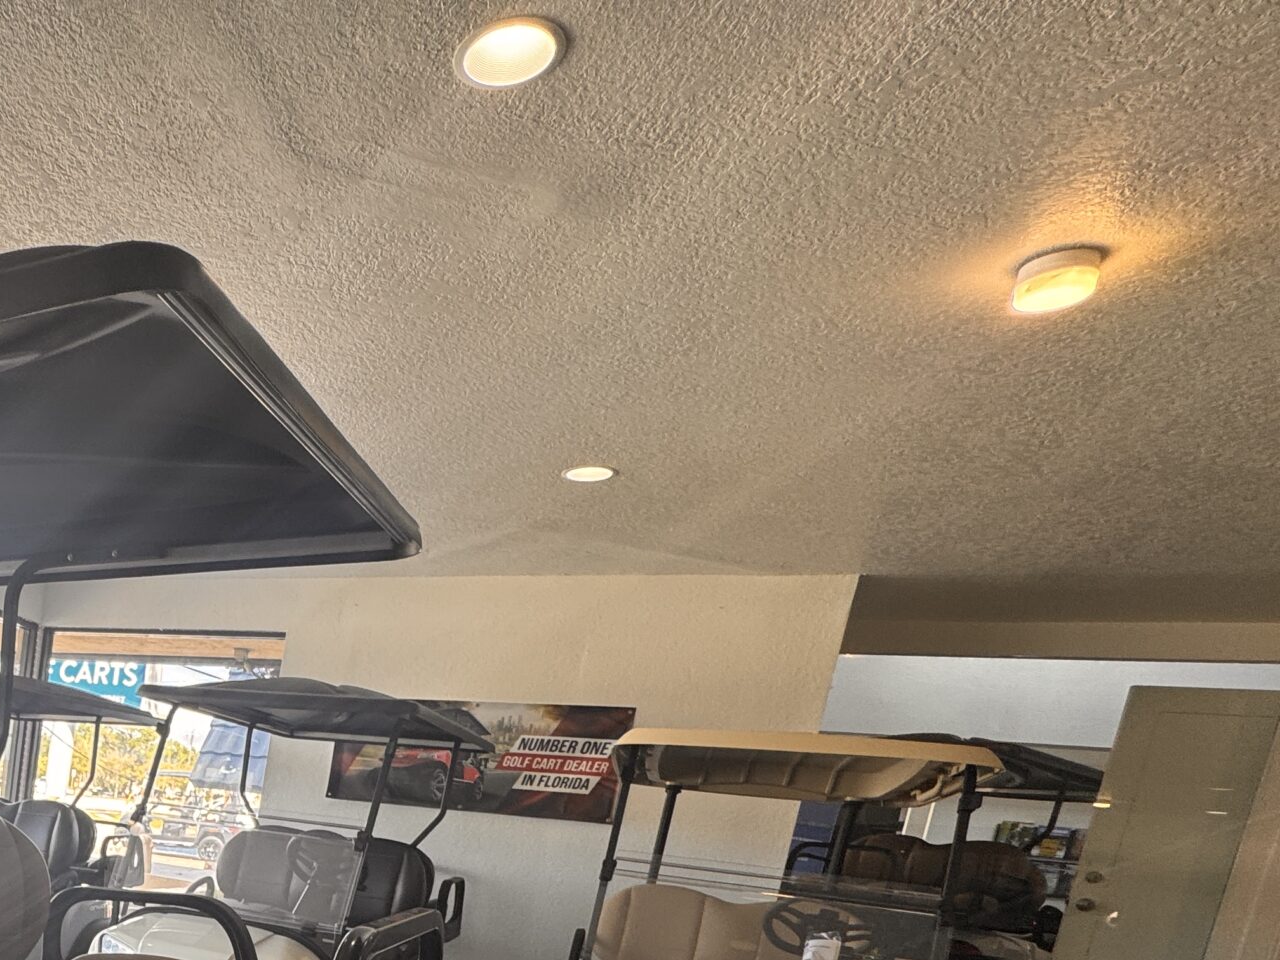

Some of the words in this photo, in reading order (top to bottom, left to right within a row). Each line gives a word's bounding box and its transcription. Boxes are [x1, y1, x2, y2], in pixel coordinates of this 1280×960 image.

[59, 659, 138, 687] CARTS
[517, 738, 579, 755] NUMBER
[580, 741, 613, 756] ONE
[502, 755, 532, 769] GOLF
[532, 756, 564, 771] CART
[563, 759, 610, 774] DEALER
[521, 774, 536, 787] IN
[536, 775, 591, 791] FLORIDA
